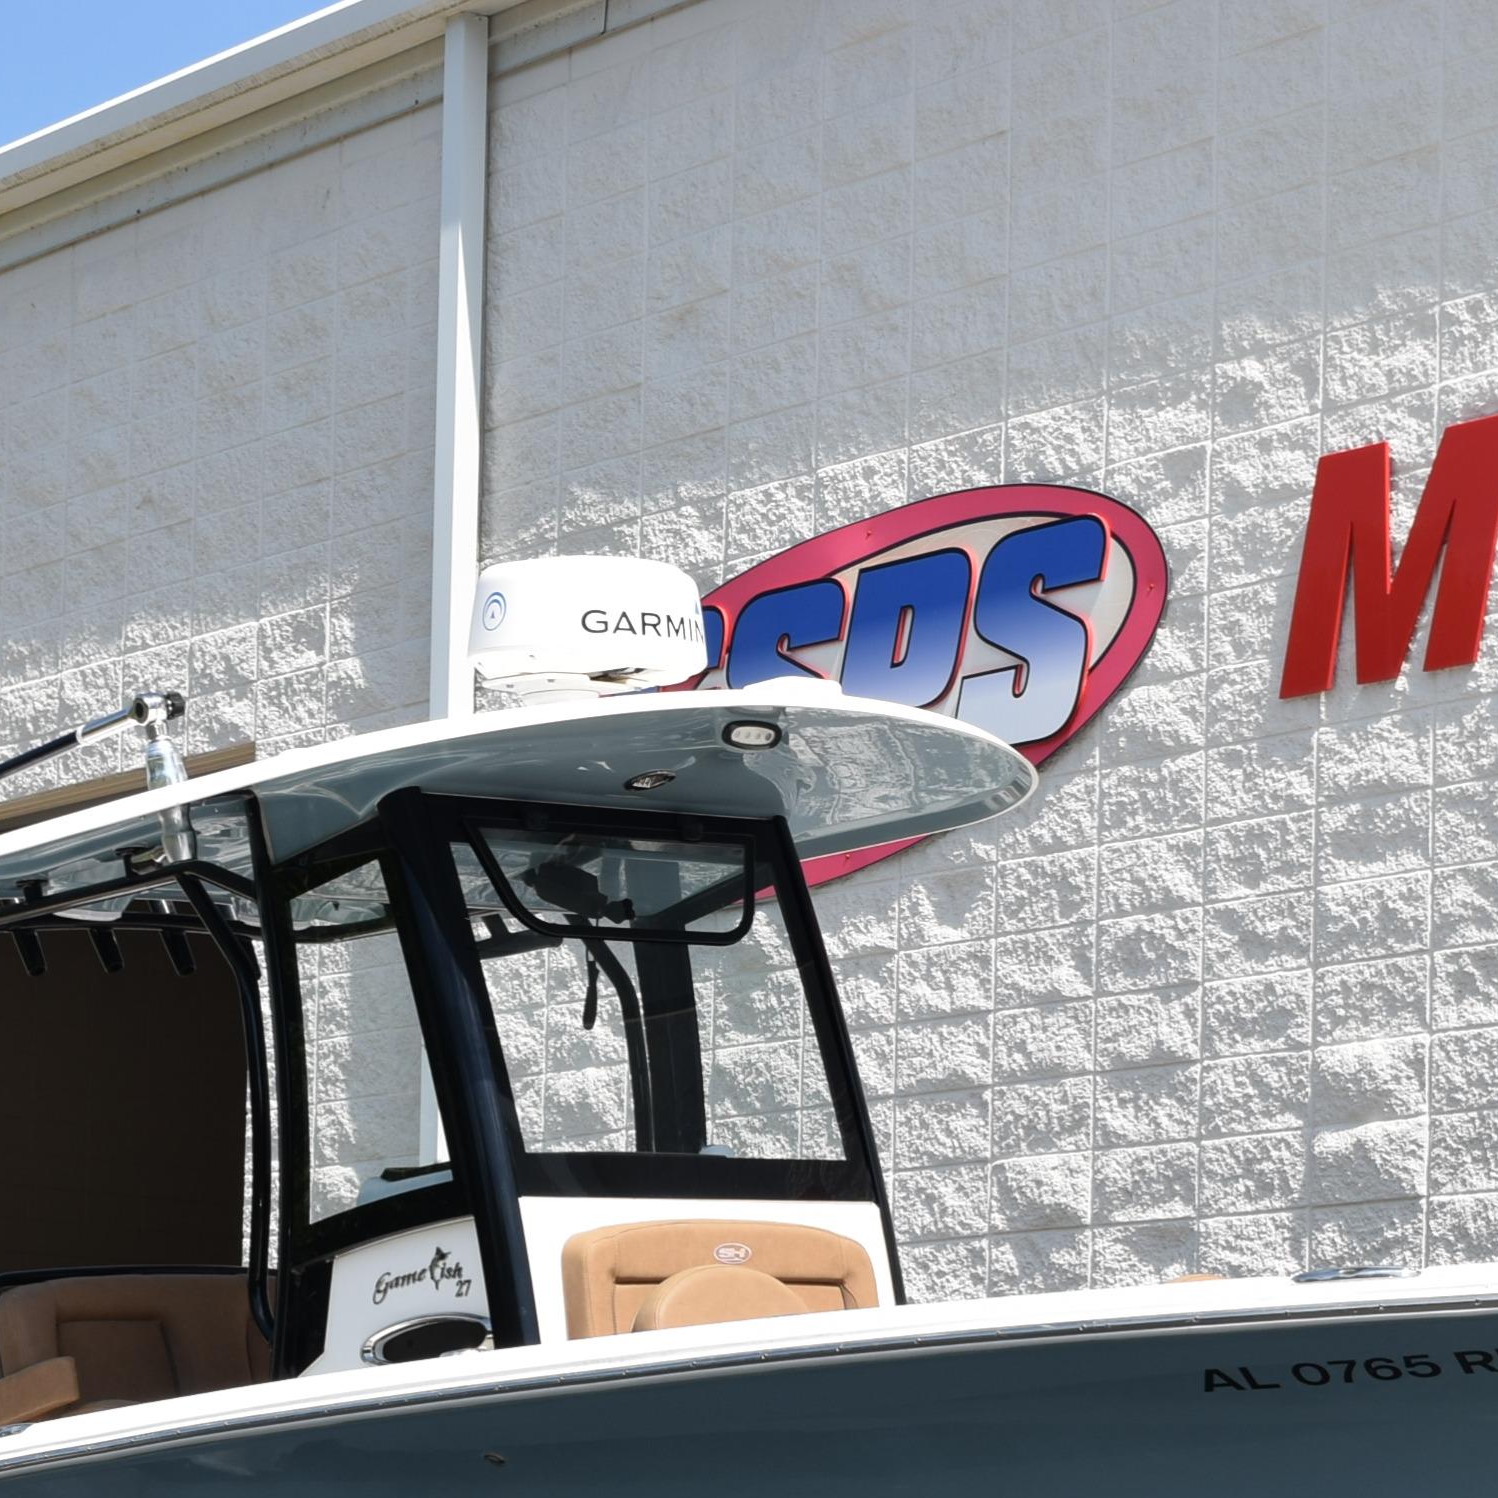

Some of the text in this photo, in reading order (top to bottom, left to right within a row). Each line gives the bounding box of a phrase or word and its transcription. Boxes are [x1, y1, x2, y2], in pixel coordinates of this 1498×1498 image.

[455, 1279, 472, 1298] 27
[1204, 1366, 1281, 1392] AL
[1291, 1354, 1442, 1386] 0765
